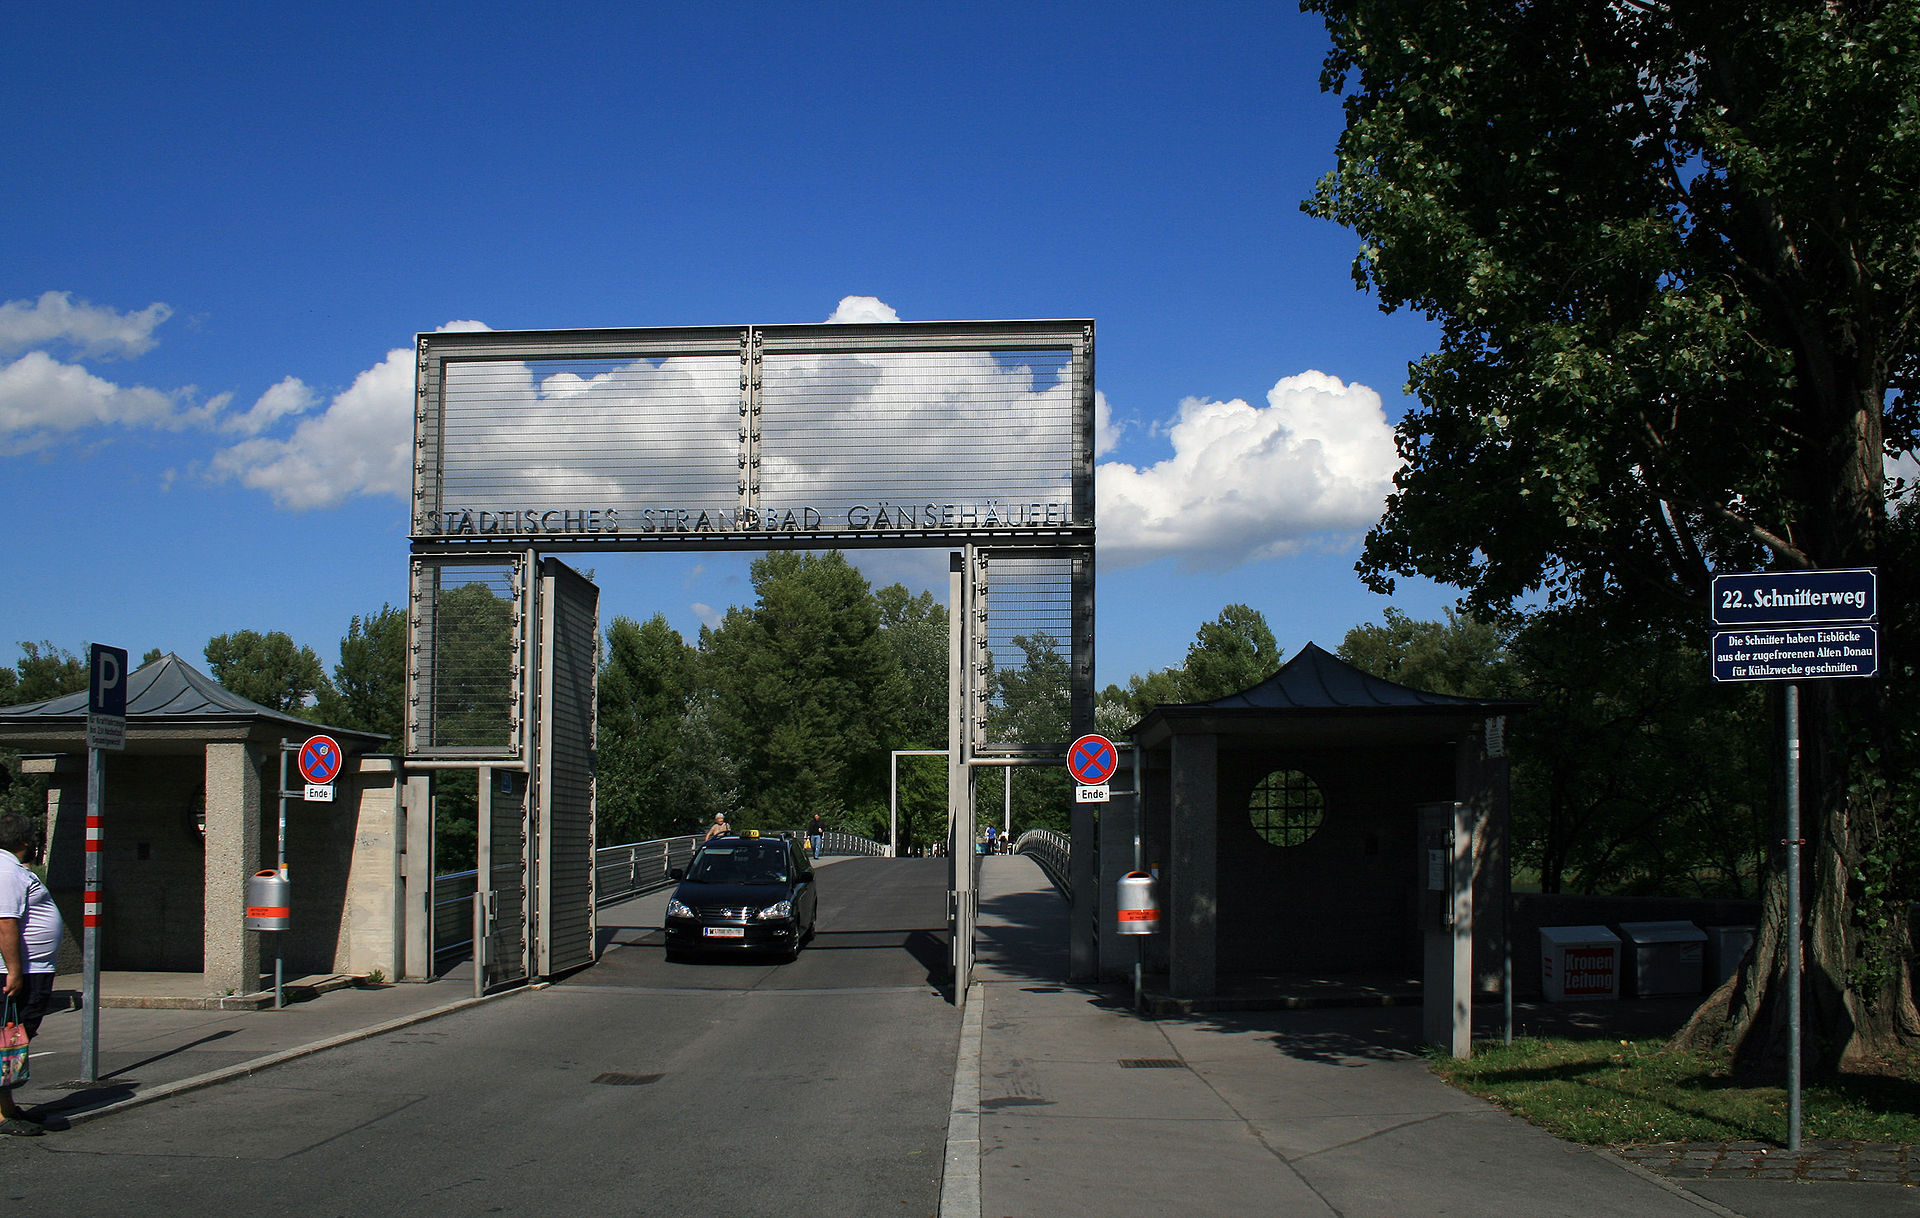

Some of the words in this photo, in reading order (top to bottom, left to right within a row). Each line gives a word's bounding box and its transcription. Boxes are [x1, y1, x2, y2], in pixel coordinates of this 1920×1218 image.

[427, 508, 619, 535] STÄDTISCHES
[641, 507, 821, 532] STRANDBAD
[848, 499, 1073, 529] GÄNSEHÄUFEL
[1754, 588, 1866, 609] Schnitterweg
[1728, 635, 1743, 646] Die
[1745, 634, 1784, 645] Schnitter
[1786, 632, 1815, 644] haben
[1817, 631, 1860, 642] Eisblöcke
[1717, 654, 1733, 662] aus
[1734, 651, 1750, 661] der
[1752, 650, 1815, 662] zugefrorenen
[1817, 647, 1842, 658] Alten
[1843, 646, 1873, 657] Donau
[1732, 665, 1746, 677] für
[1748, 664, 1803, 676] Kühlzwecke
[1804, 662, 1858, 675] geschnitten
[98, 652, 120, 708] P
[309, 788, 328, 798] Ende
[1082, 789, 1104, 799] Ende
[1566, 953, 1613, 970] Kronen
[1564, 971, 1613, 990] Zeitung
